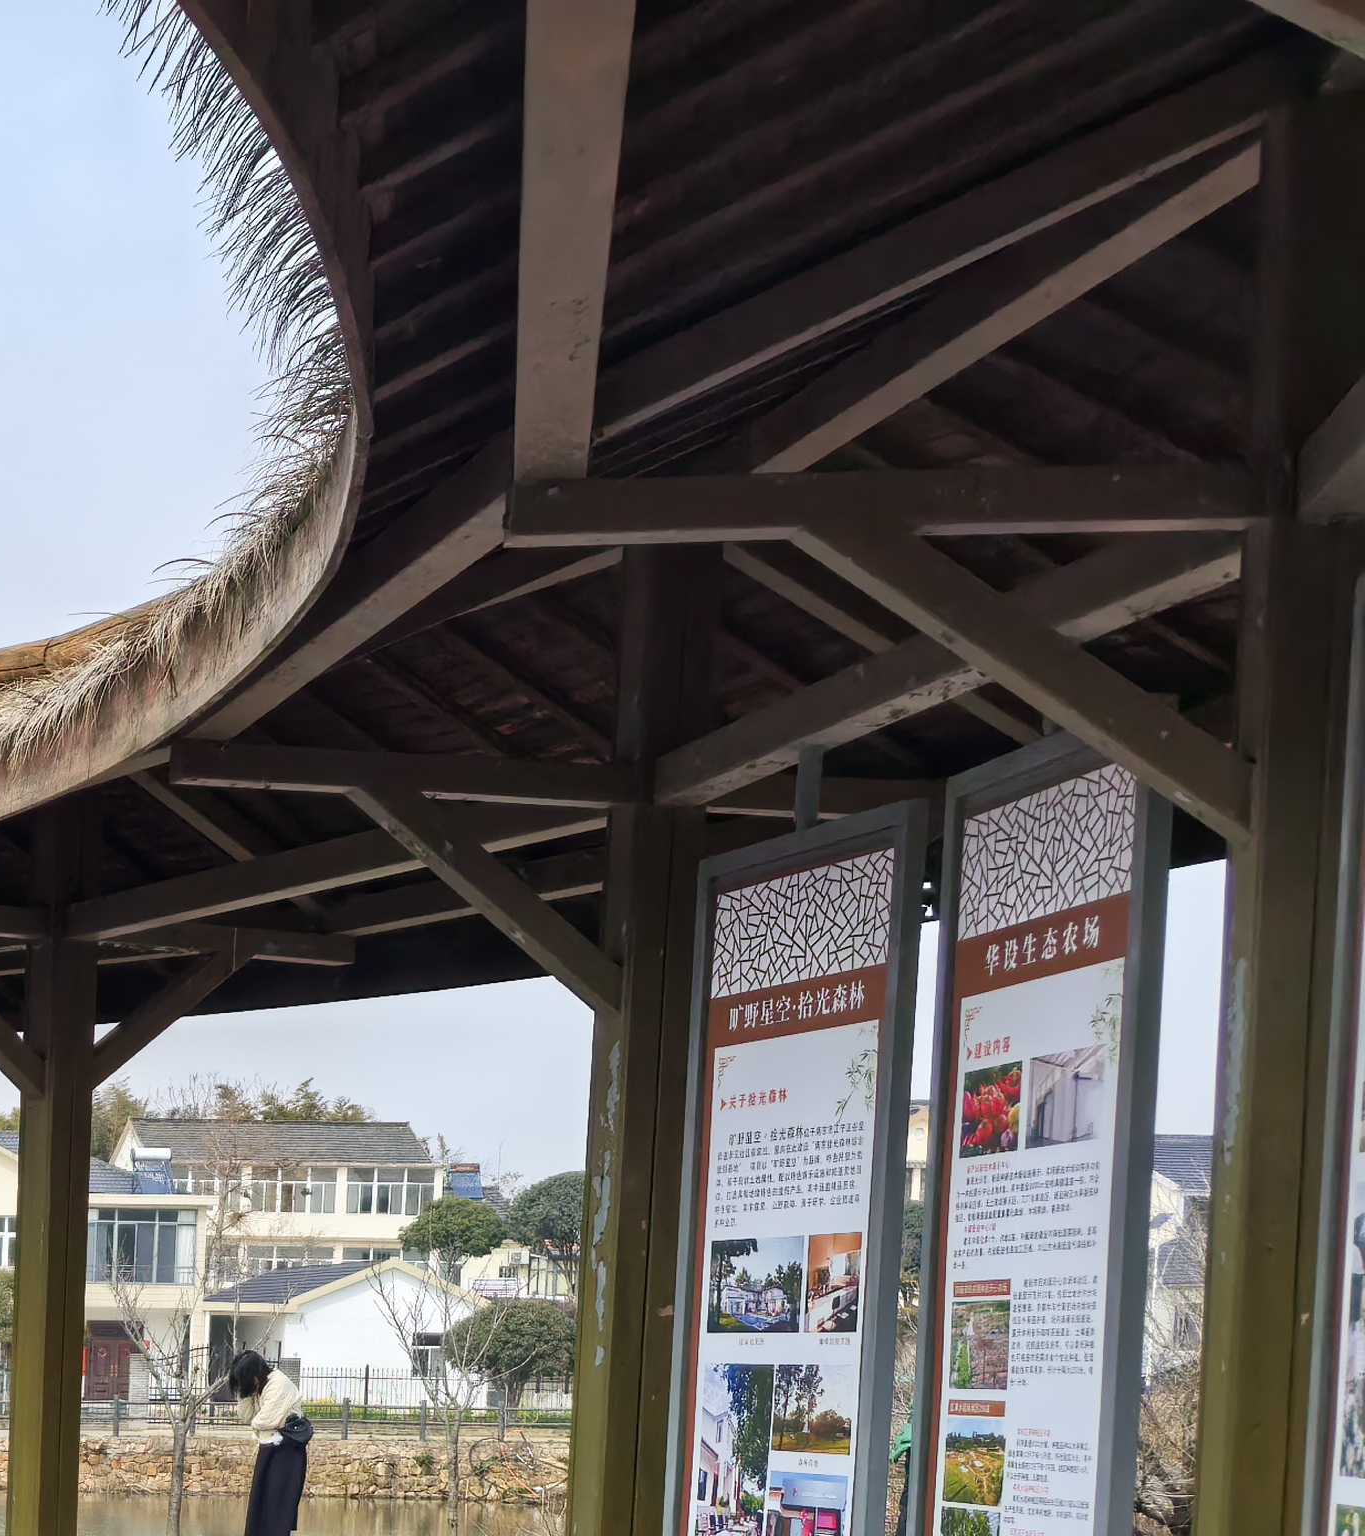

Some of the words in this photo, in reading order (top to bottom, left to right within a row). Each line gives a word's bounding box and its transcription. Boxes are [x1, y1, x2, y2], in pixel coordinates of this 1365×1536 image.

[984, 915, 1100, 976] 华设生态农场
[728, 979, 865, 1031] 旷野星空·拾光森林
[728, 1087, 787, 1110] 关于拾光森林
